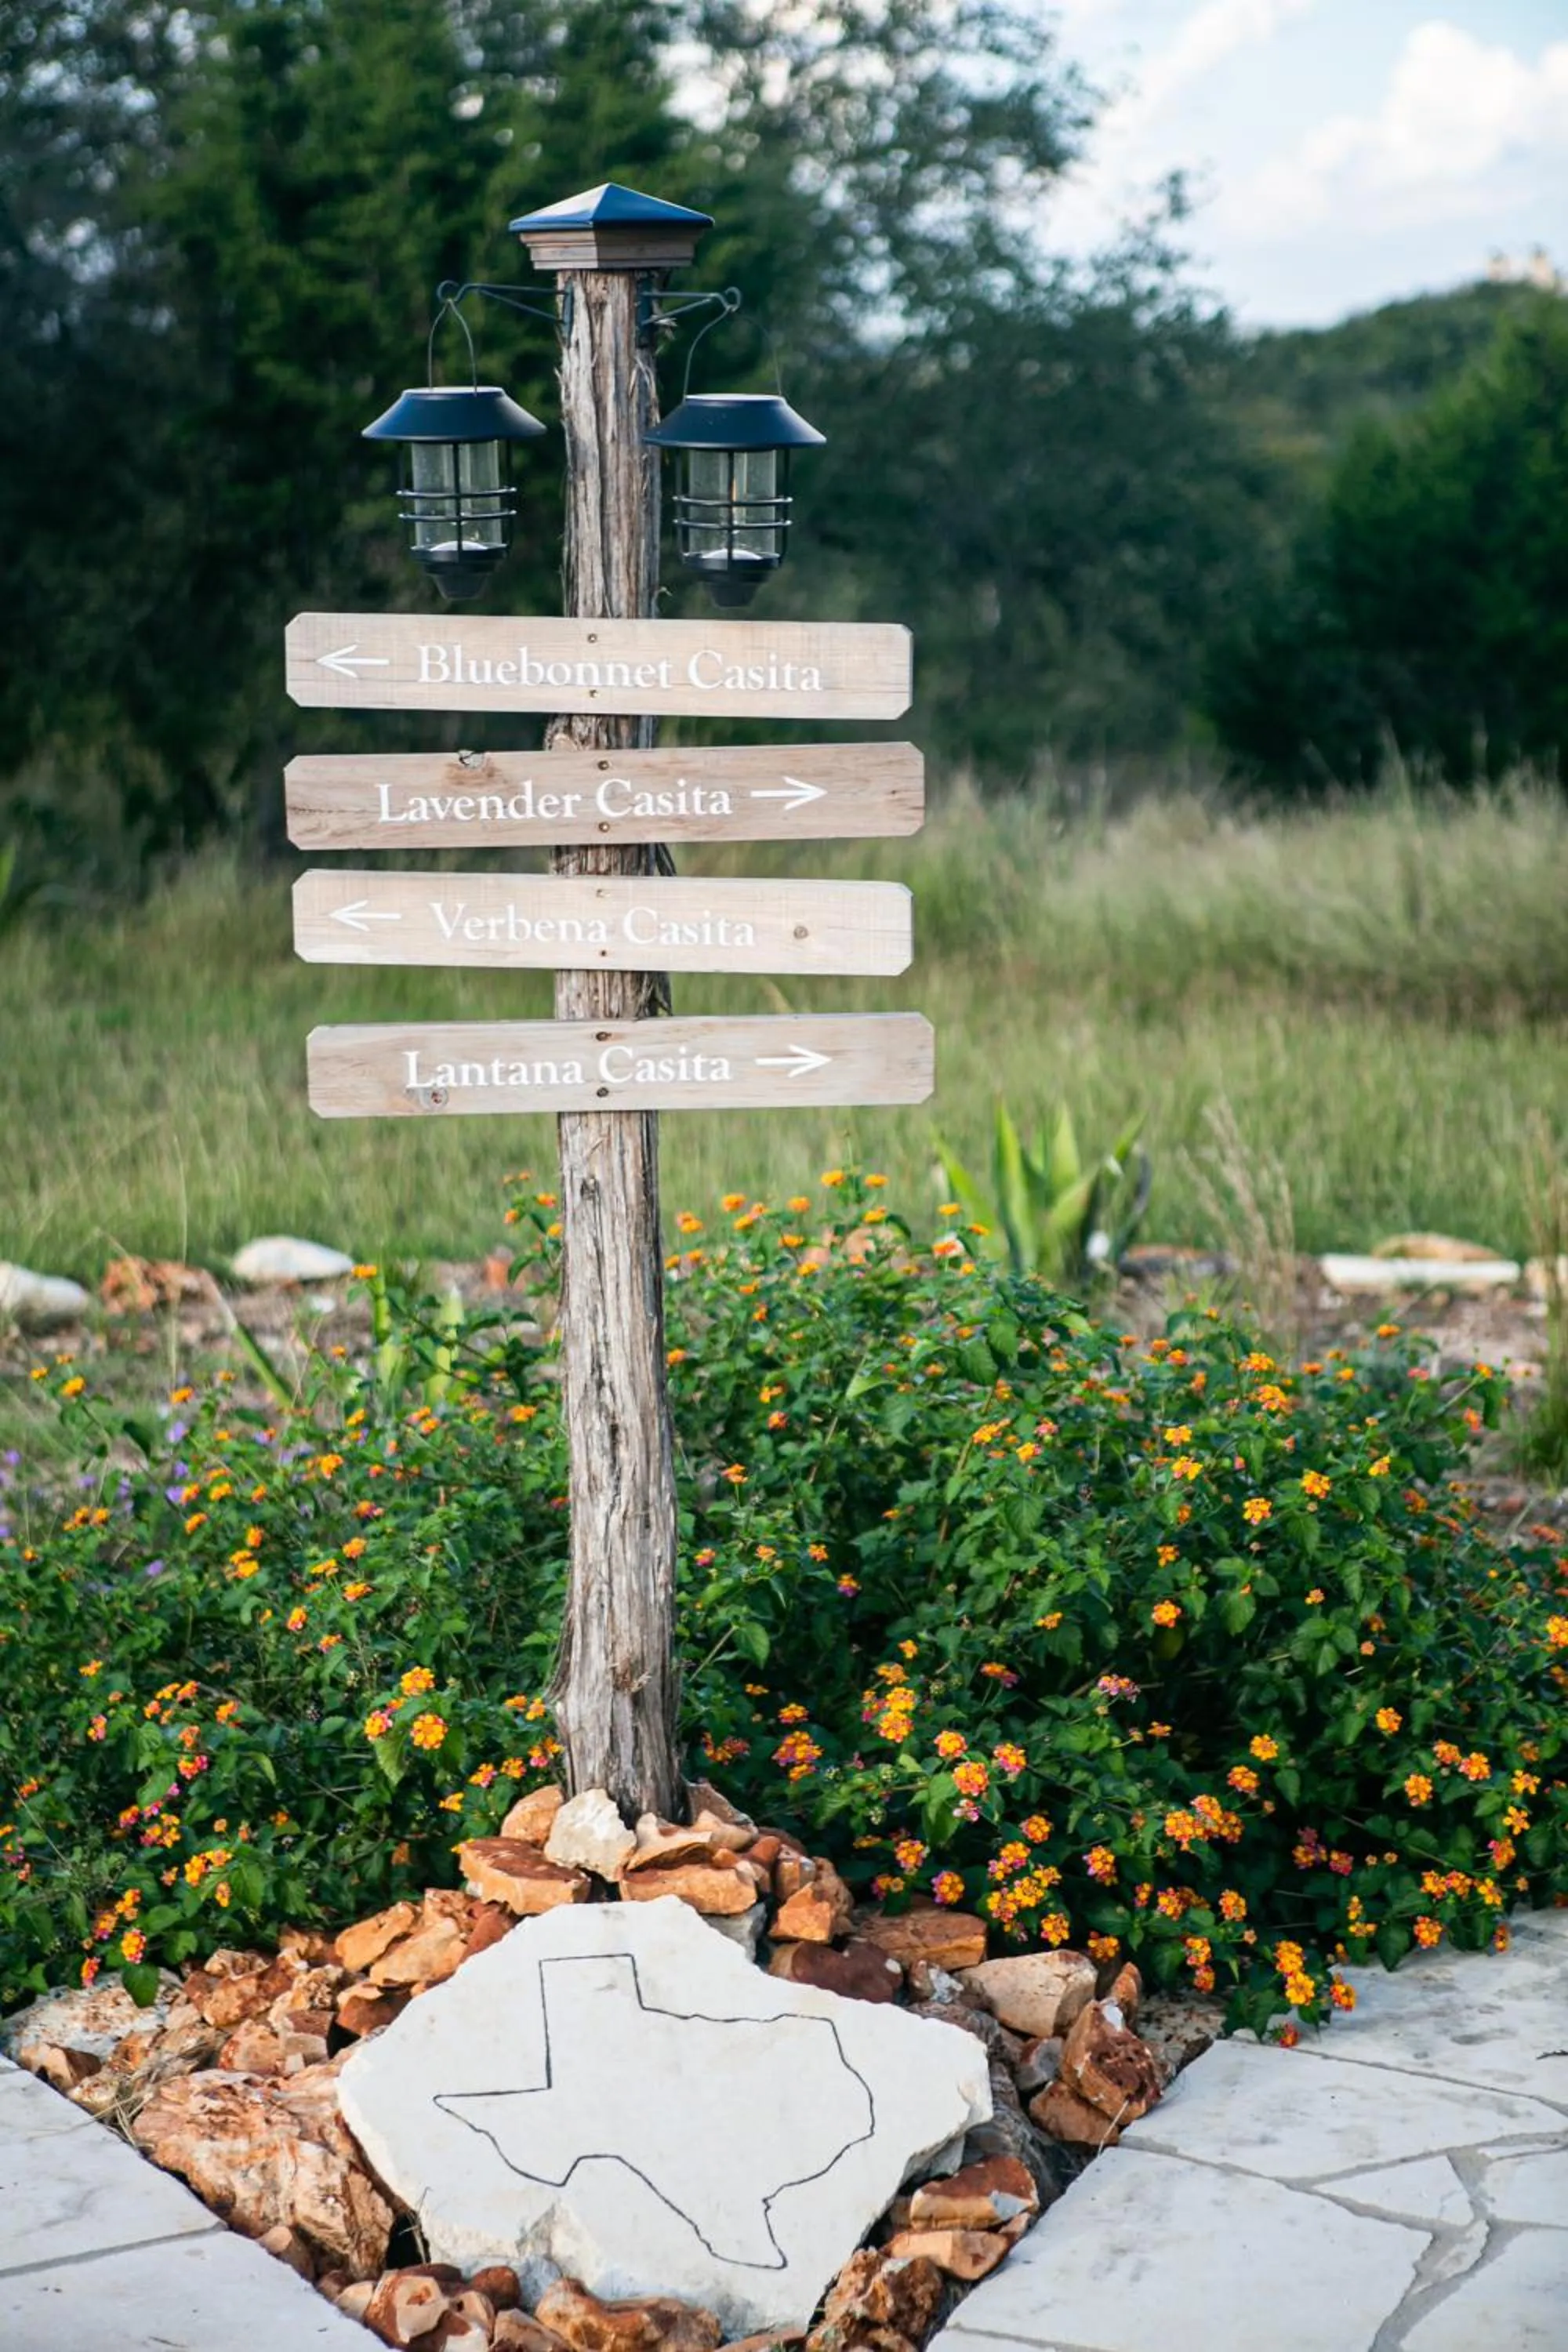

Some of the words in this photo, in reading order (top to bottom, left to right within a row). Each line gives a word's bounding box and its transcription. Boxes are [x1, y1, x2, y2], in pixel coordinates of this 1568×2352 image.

[417, 644, 671, 689] Bluebonnet
[688, 650, 822, 692] Casita
[376, 782, 581, 823] Lavender
[595, 777, 732, 818] Casita
[429, 902, 608, 944] Verbena
[622, 906, 755, 947] Casita
[404, 1050, 584, 1089] Lantana
[597, 1045, 731, 1085] Casita
